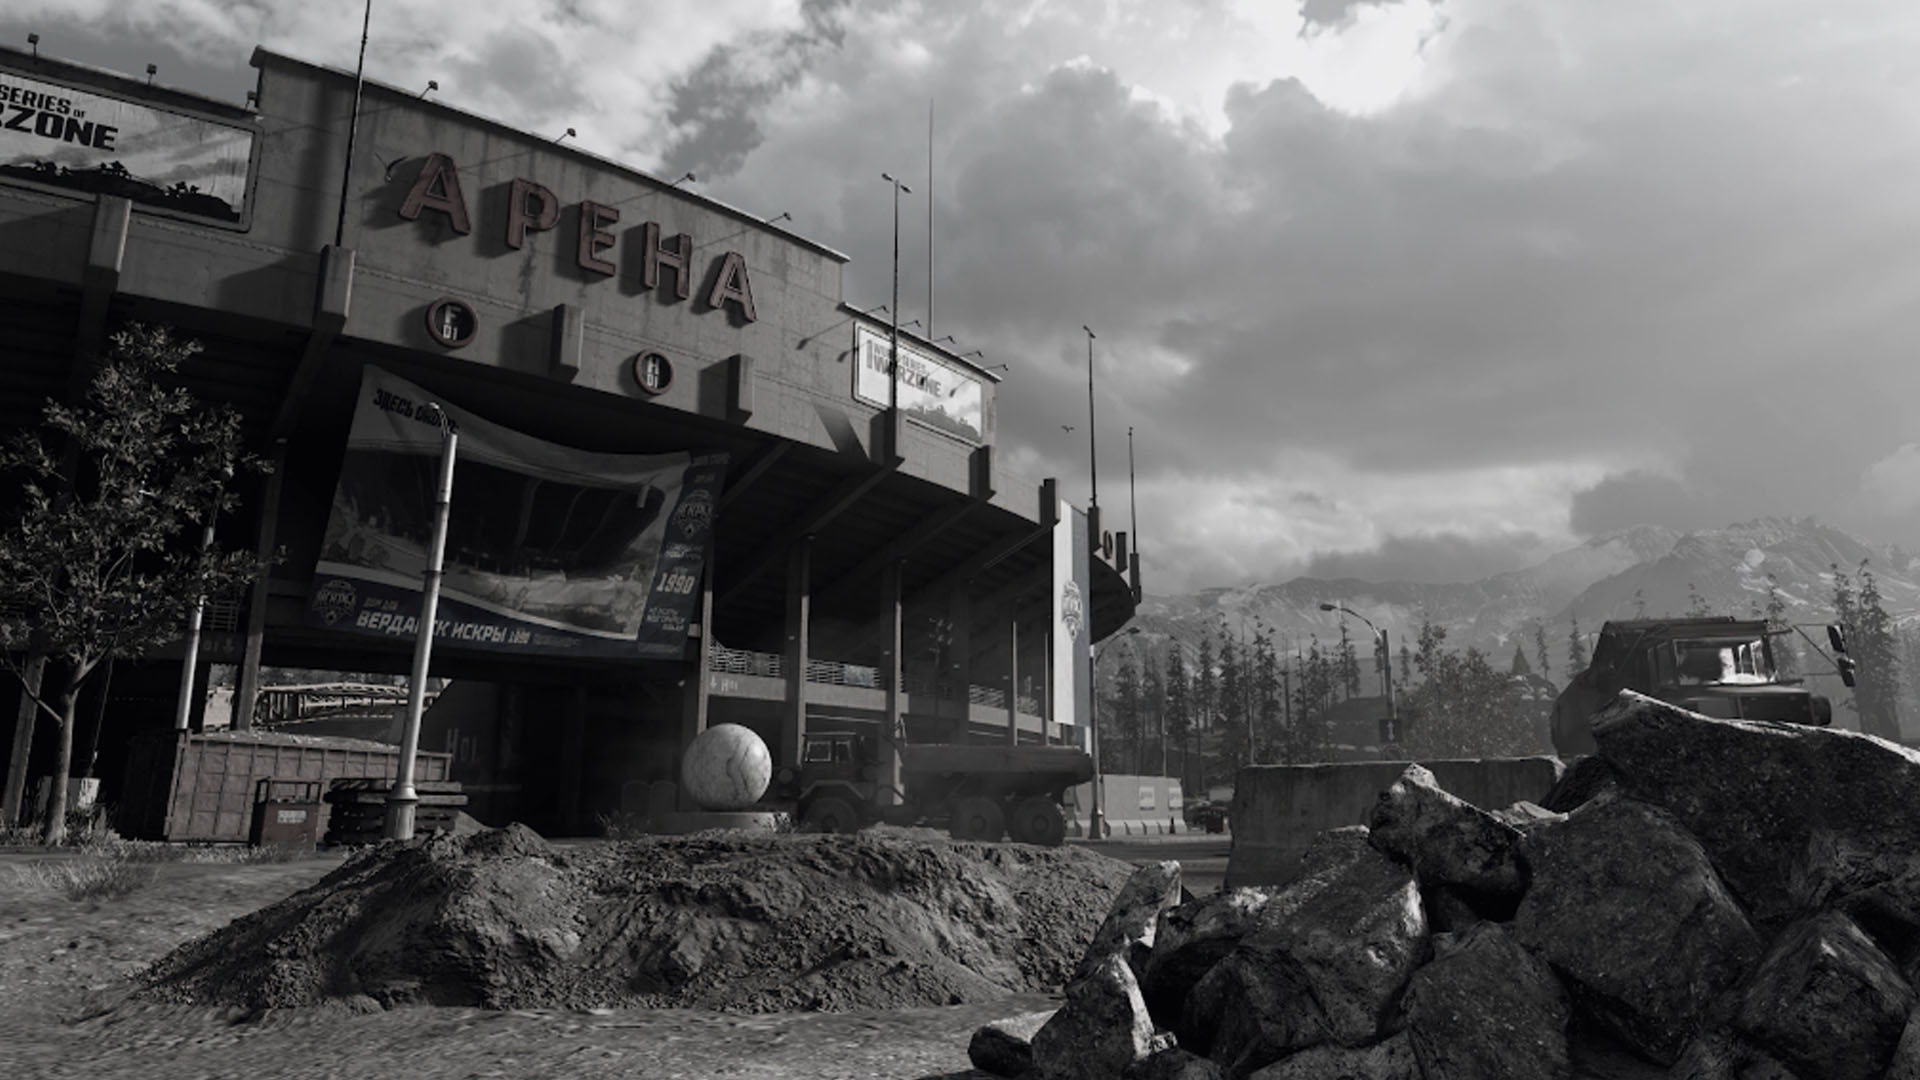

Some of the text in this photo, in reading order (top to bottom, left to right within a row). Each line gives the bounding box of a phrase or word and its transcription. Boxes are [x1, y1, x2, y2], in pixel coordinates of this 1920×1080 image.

[0, 84, 71, 115] SERIES
[0, 102, 118, 151] ZONE
[399, 152, 757, 322] АРЕНА
[874, 354, 942, 398] WRZONE
[356, 610, 449, 637] ВЕРДАК
[451, 622, 508, 643] ИСКРЫ
